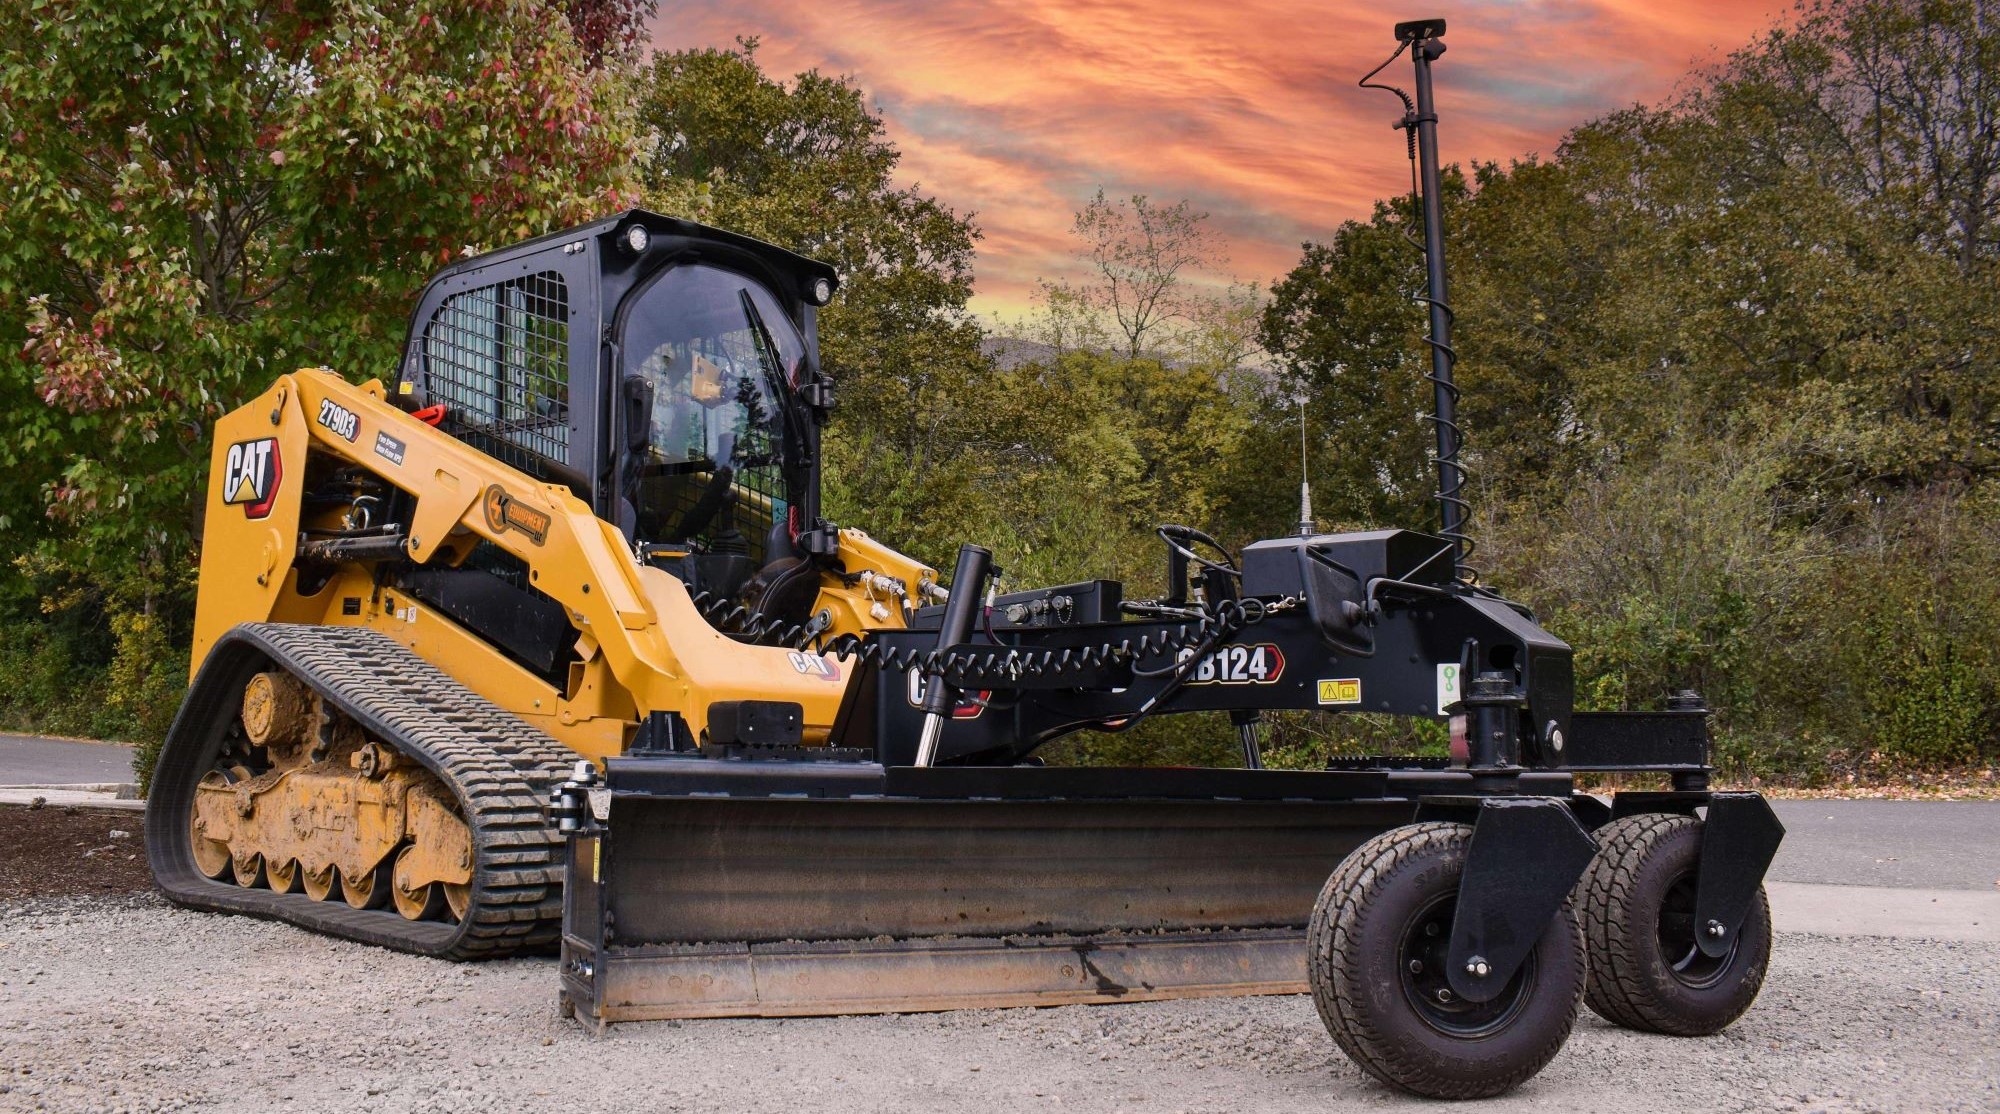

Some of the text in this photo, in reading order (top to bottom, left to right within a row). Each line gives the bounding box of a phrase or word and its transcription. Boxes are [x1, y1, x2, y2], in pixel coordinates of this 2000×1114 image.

[318, 399, 356, 439] 279D3
[225, 439, 272, 503] CAT
[787, 651, 830, 675] CAT
